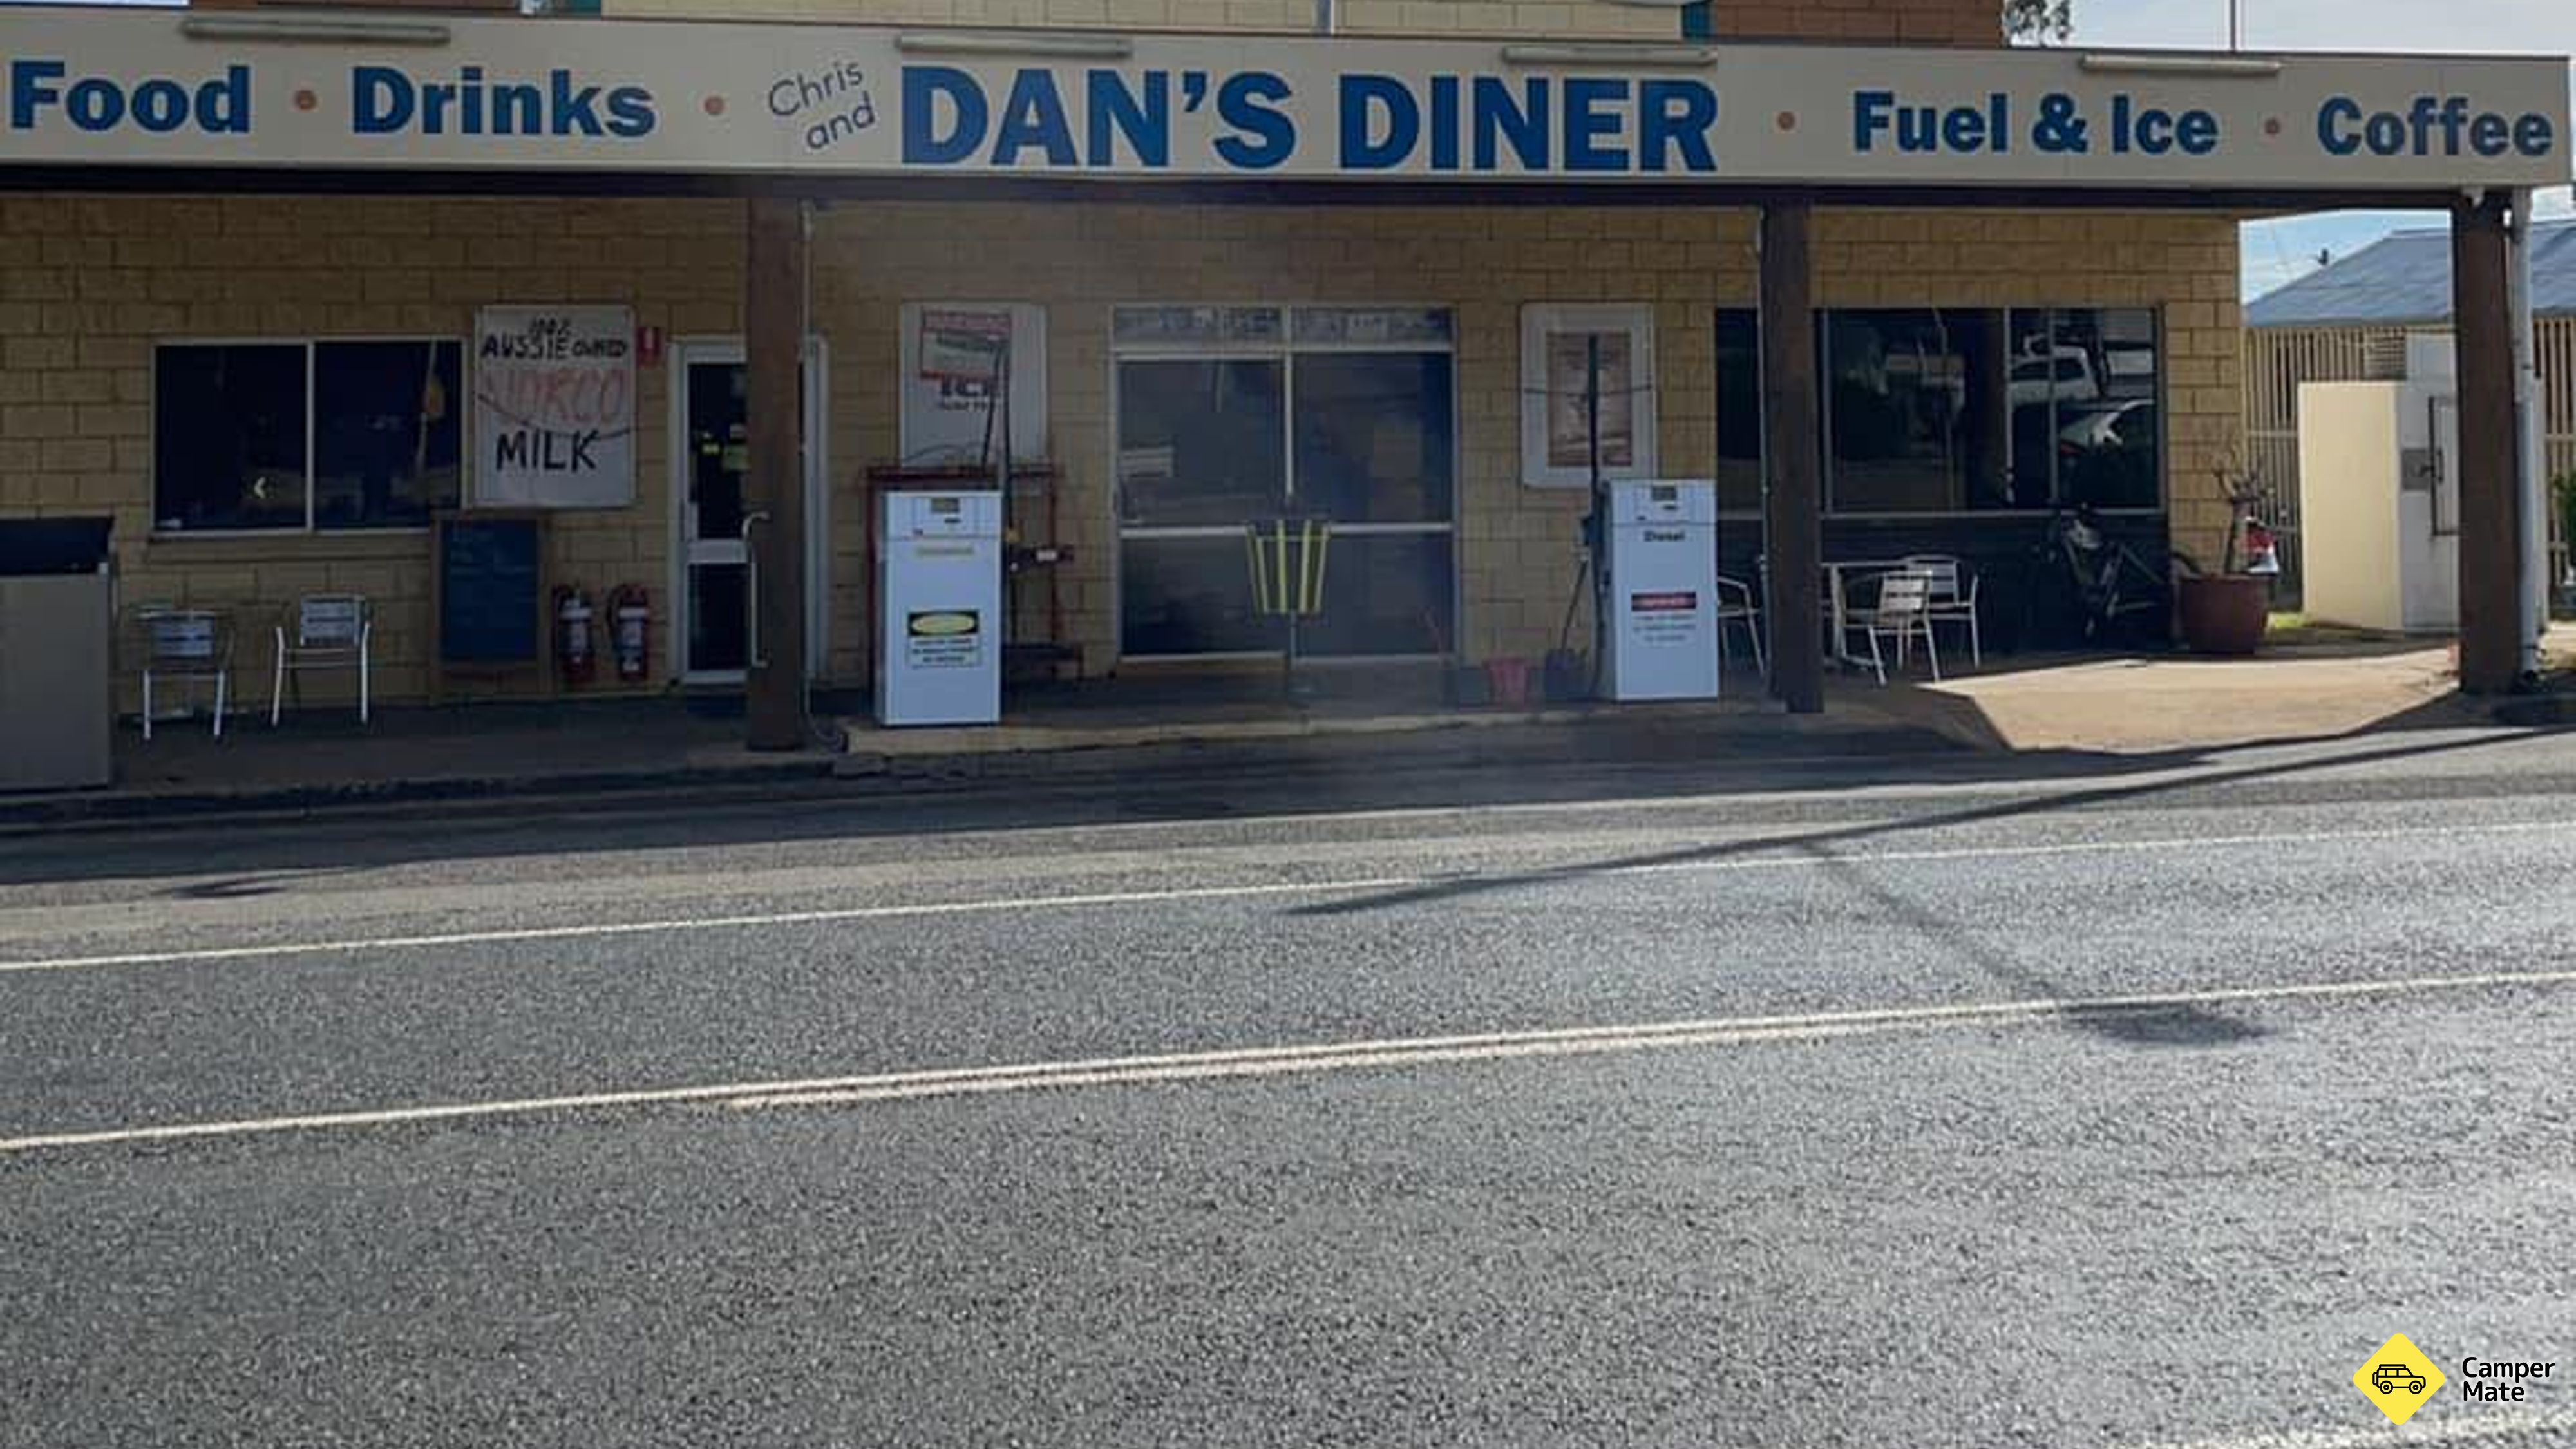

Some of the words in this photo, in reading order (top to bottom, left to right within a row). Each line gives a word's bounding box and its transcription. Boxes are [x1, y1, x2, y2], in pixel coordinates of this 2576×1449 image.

[10, 59, 252, 134] Food
[352, 66, 656, 138] Drinks
[769, 61, 864, 116] Chris
[806, 89, 875, 149] and
[901, 66, 1298, 172] DAN'S
[1338, 74, 1718, 176] DINER
[1853, 90, 2009, 155] Fuel
[2032, 93, 2088, 155] &
[2111, 95, 2219, 155] Ice
[2316, 95, 2553, 156] Coffee
[480, 331, 568, 360] AUSSIE
[495, 428, 600, 473] MILK
